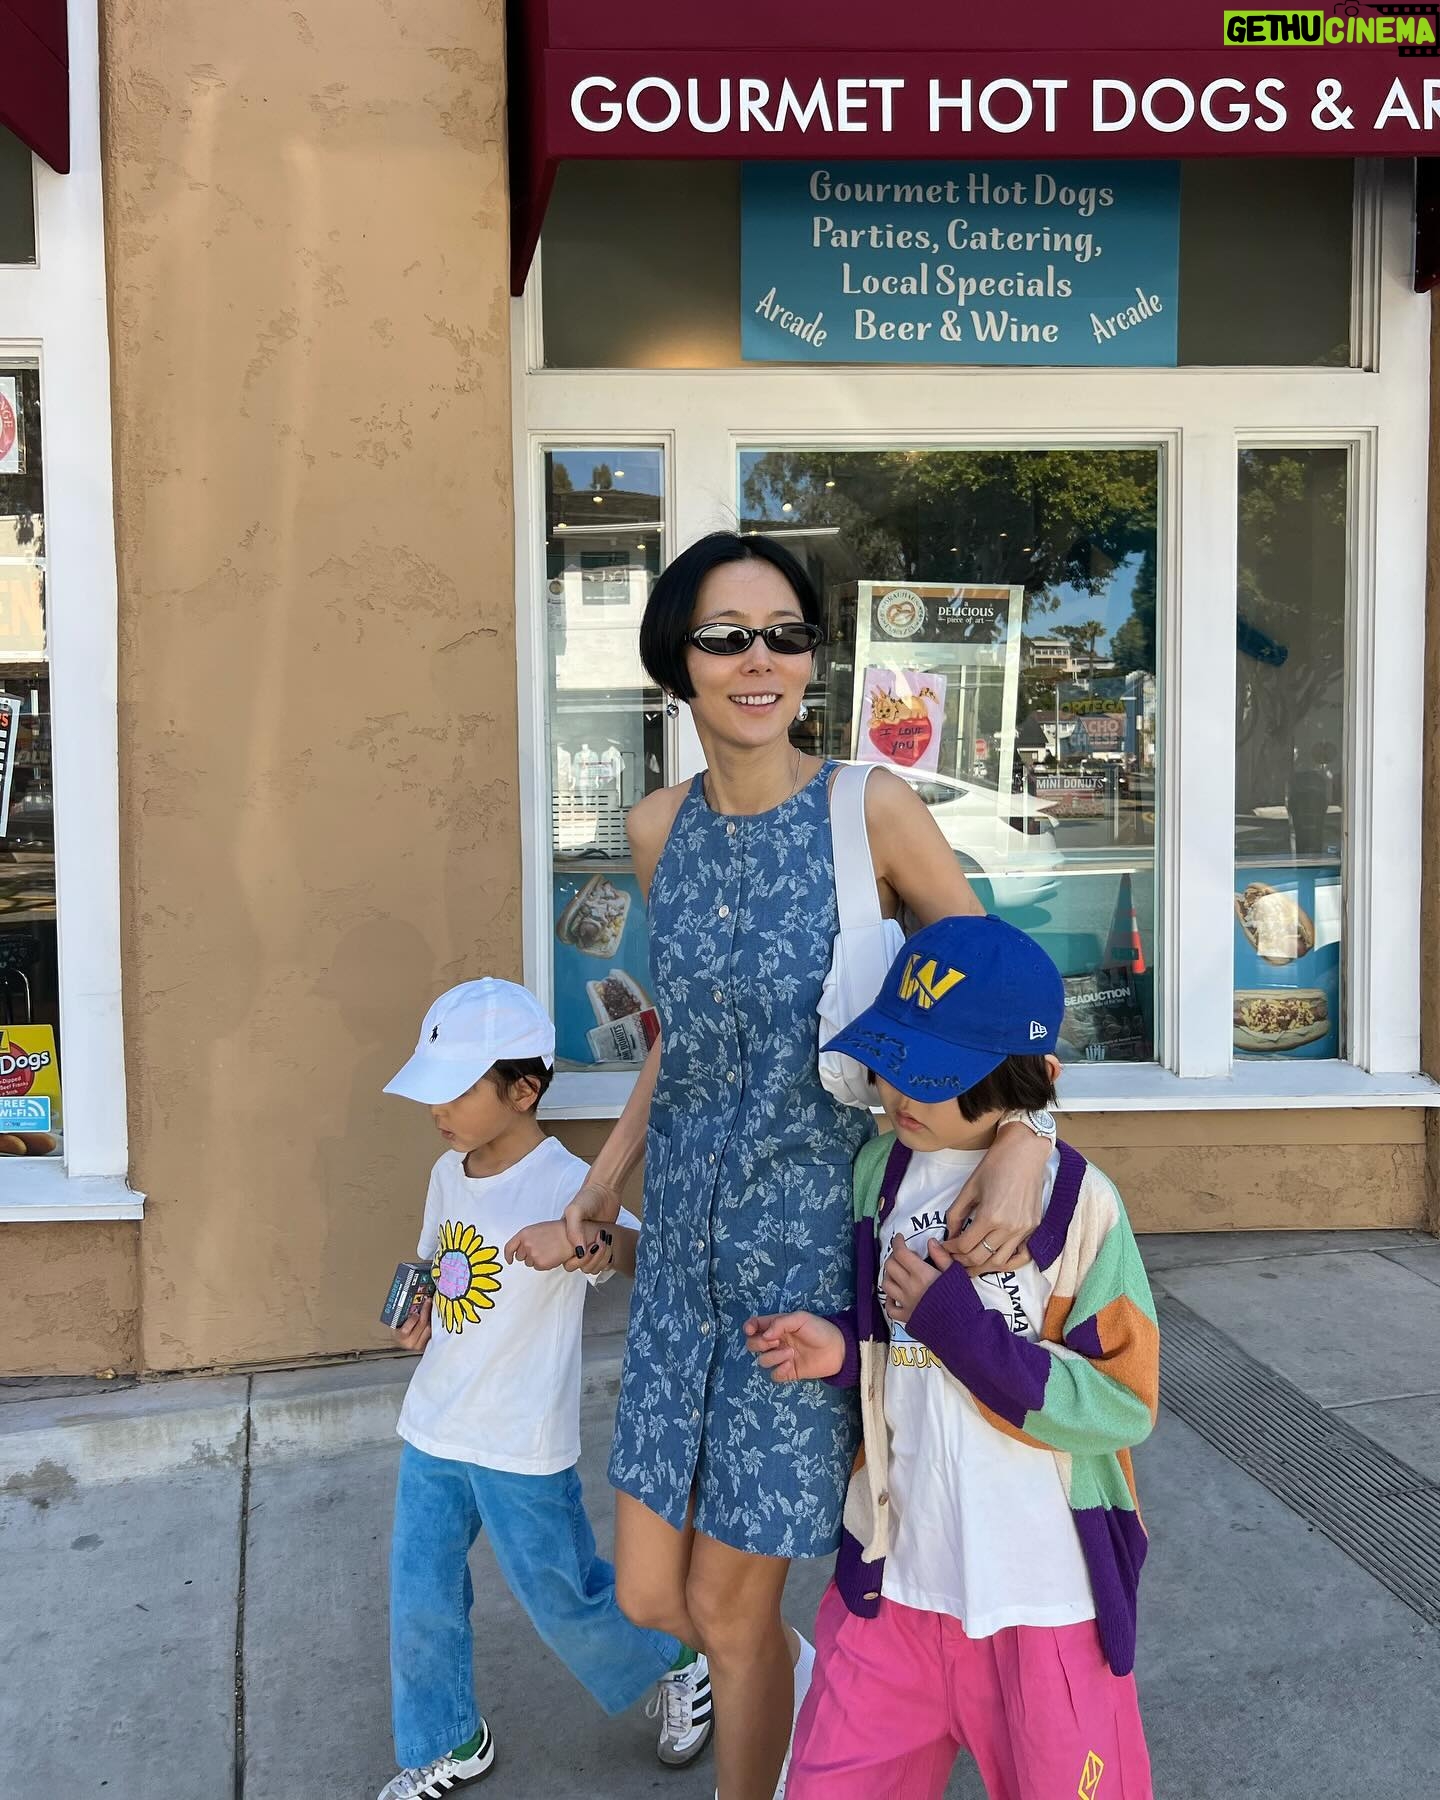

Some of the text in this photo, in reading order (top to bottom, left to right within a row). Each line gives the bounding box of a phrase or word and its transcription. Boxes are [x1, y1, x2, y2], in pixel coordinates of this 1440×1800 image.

[570, 76, 904, 133] GOURMET
[929, 77, 1068, 133] HOT
[1092, 77, 1288, 133] DOGS
[1310, 77, 1355, 131] &
[809, 170, 1114, 217] Gourmet Hot Dogs
[812, 216, 1102, 263] Parties, Catering,
[842, 262, 1073, 307] Local Specials
[755, 287, 828, 348] Arcade
[854, 308, 1059, 343] Beer & Wine
[1090, 287, 1163, 344] Arcade
[938, 606, 995, 617] DELICIOUS
[1036, 777, 1104, 790] MINI DONUTS
[1064, 986, 1131, 1007] SEADUCTION
[0, 1051, 50, 1075] Dogs
